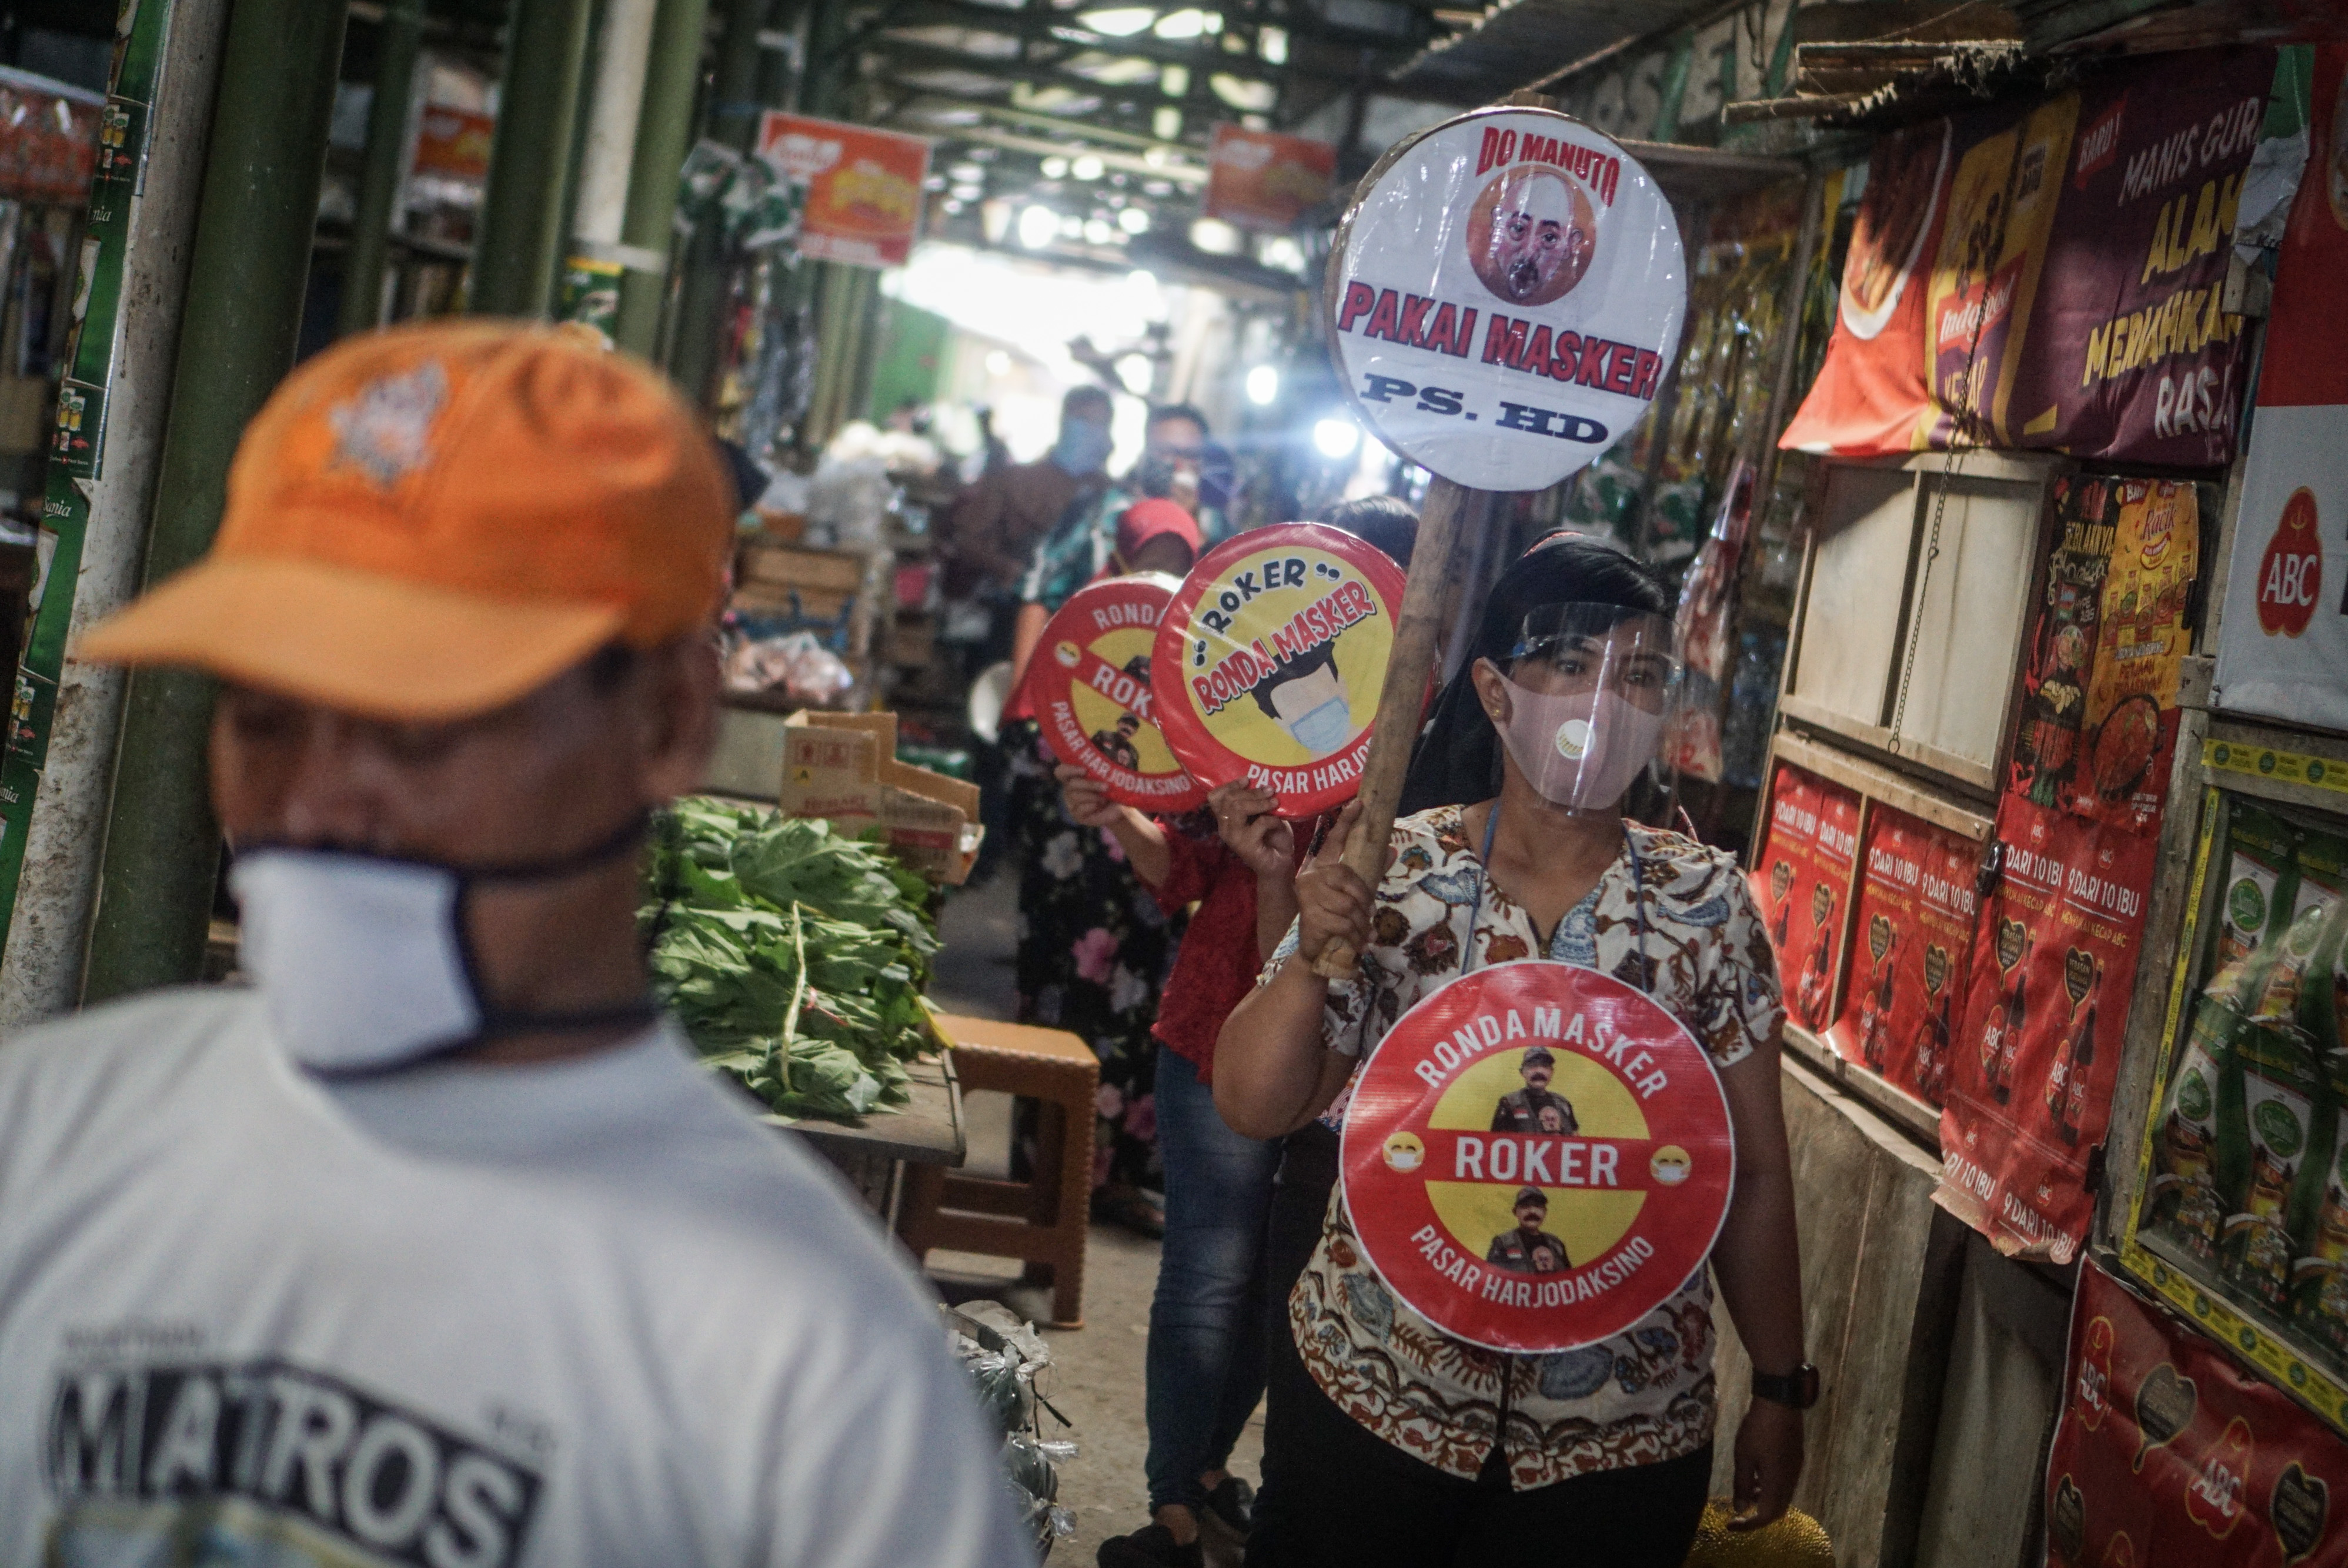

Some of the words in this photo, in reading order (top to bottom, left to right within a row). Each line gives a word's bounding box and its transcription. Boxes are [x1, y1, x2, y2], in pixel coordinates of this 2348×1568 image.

[1476, 126, 1516, 177] DO
[1518, 132, 1620, 208] MANUTO
[2118, 123, 2199, 205] MANIS
[1338, 280, 1478, 359] PAKAI
[1481, 313, 1664, 401] MASKER
[1360, 373, 1477, 422] PS.
[1495, 401, 1609, 444] HD
[1944, 356, 1988, 413] KEAP
[2261, 553, 2317, 606] ABC
[1191, 638, 1277, 715] RONDA
[1270, 580, 1378, 664] MASKER
[1092, 664, 1156, 728] ROK
[1053, 700, 1086, 758] PASAR
[1869, 847, 1875, 868] 9
[1873, 849, 1893, 877] DARI
[1894, 857, 1903, 881] 10
[1903, 860, 1919, 887] IBU
[2006, 844, 2032, 876] DARI
[2033, 855, 2046, 881] 10
[1922, 873, 1929, 894] 9
[1928, 875, 1949, 904] DARI
[1950, 884, 1961, 909] 10
[2068, 868, 2075, 892] 9
[2073, 871, 2101, 903] DARI
[2102, 881, 2116, 910] 10
[2116, 887, 2140, 918] IBU
[2091, 921, 2112, 942] KECAP
[2112, 932, 2129, 948] ABC
[1414, 1008, 1527, 1089] RONDA
[1532, 1006, 1669, 1100] MASKER
[1984, 1026, 2002, 1050] ABC
[2050, 1060, 2069, 1087] ABC
[1455, 1135, 1619, 1186] ROKER
[1960, 1161, 1977, 1189] 10
[1973, 1170, 1996, 1202] IBU
[2003, 1191, 2013, 1216] 9
[2010, 1197, 2039, 1238] DARI
[1410, 1224, 1481, 1293] PASAR
[1481, 1235, 1655, 1309] HARJODAKSINO
